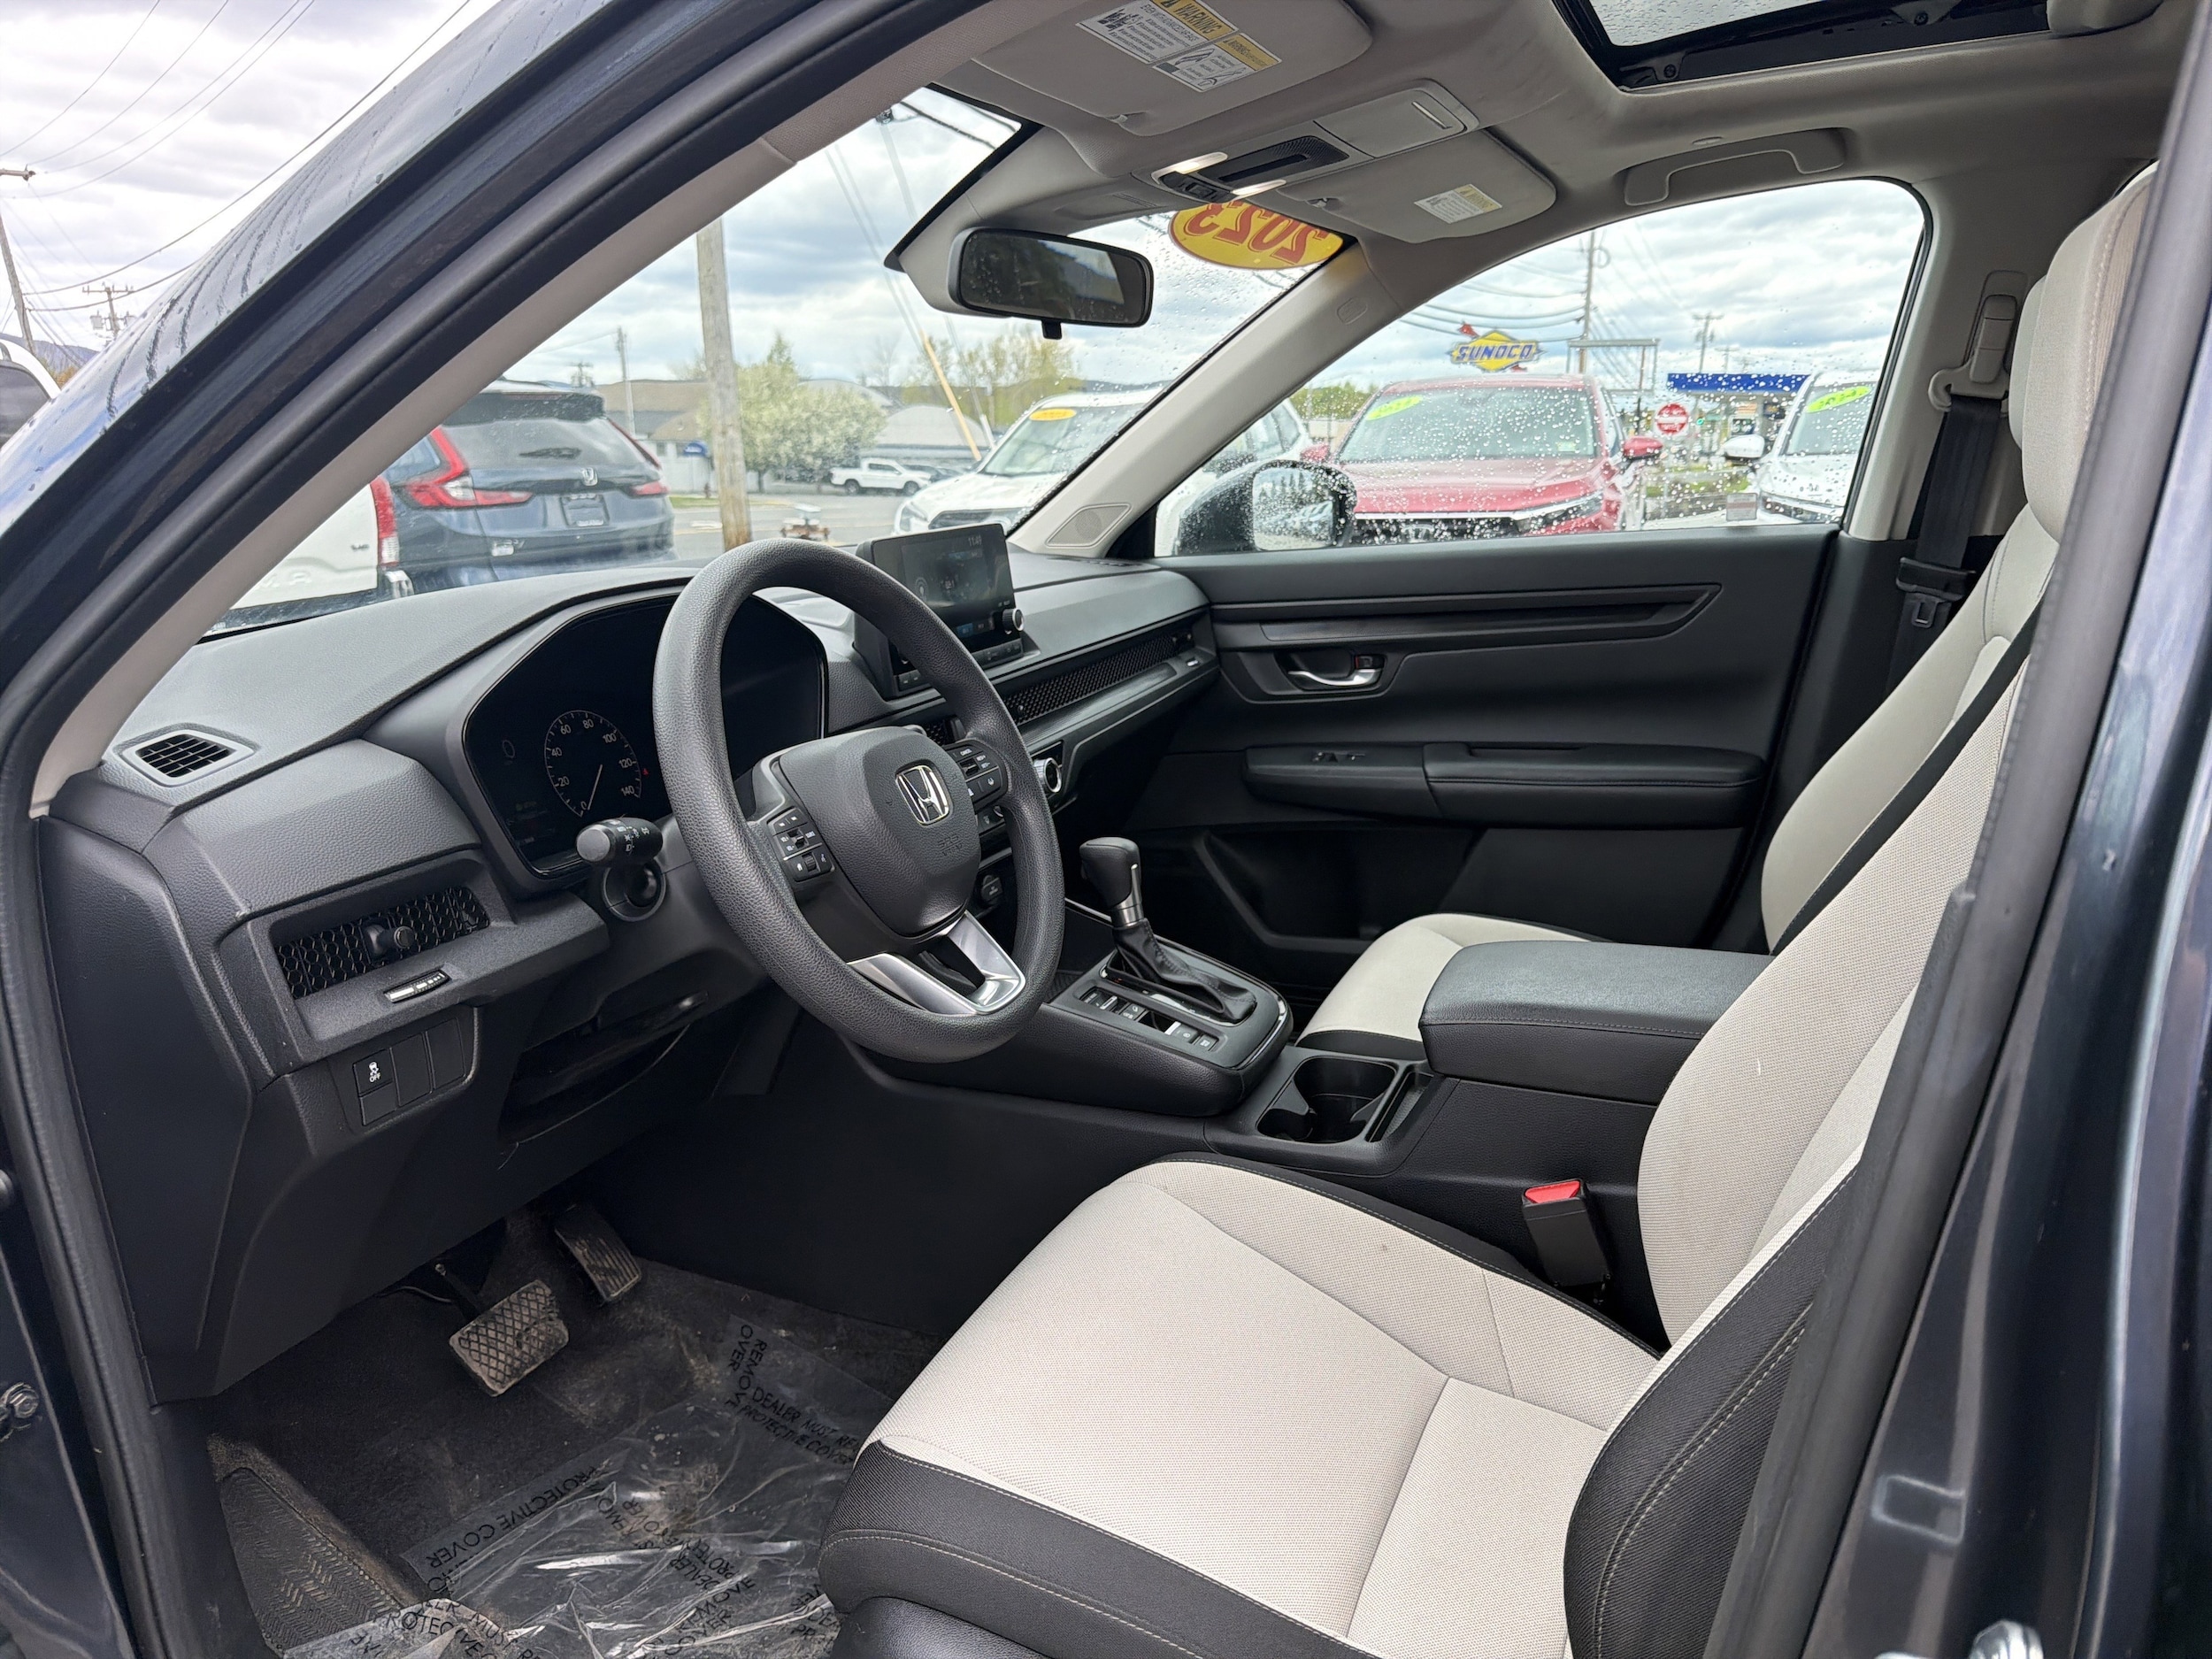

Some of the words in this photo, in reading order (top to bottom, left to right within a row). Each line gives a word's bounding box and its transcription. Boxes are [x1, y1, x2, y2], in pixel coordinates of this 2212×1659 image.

[1173, 4, 1222, 34] WARNING
[1455, 344, 1533, 361] SUNOCO
[583, 719, 594, 728] 80
[561, 725, 571, 734] 60
[603, 733, 617, 742] 100
[552, 748, 562, 757] 40
[618, 758, 633, 768] 120
[558, 776, 569, 787] 20
[621, 786, 634, 795] 140
[369, 1072, 381, 1082] OFF
[753, 1386, 802, 1423] DEALER
[801, 1418, 839, 1438] MUST
[496, 1466, 596, 1531] PROTECTIVE
[426, 1524, 495, 1568] COVER
